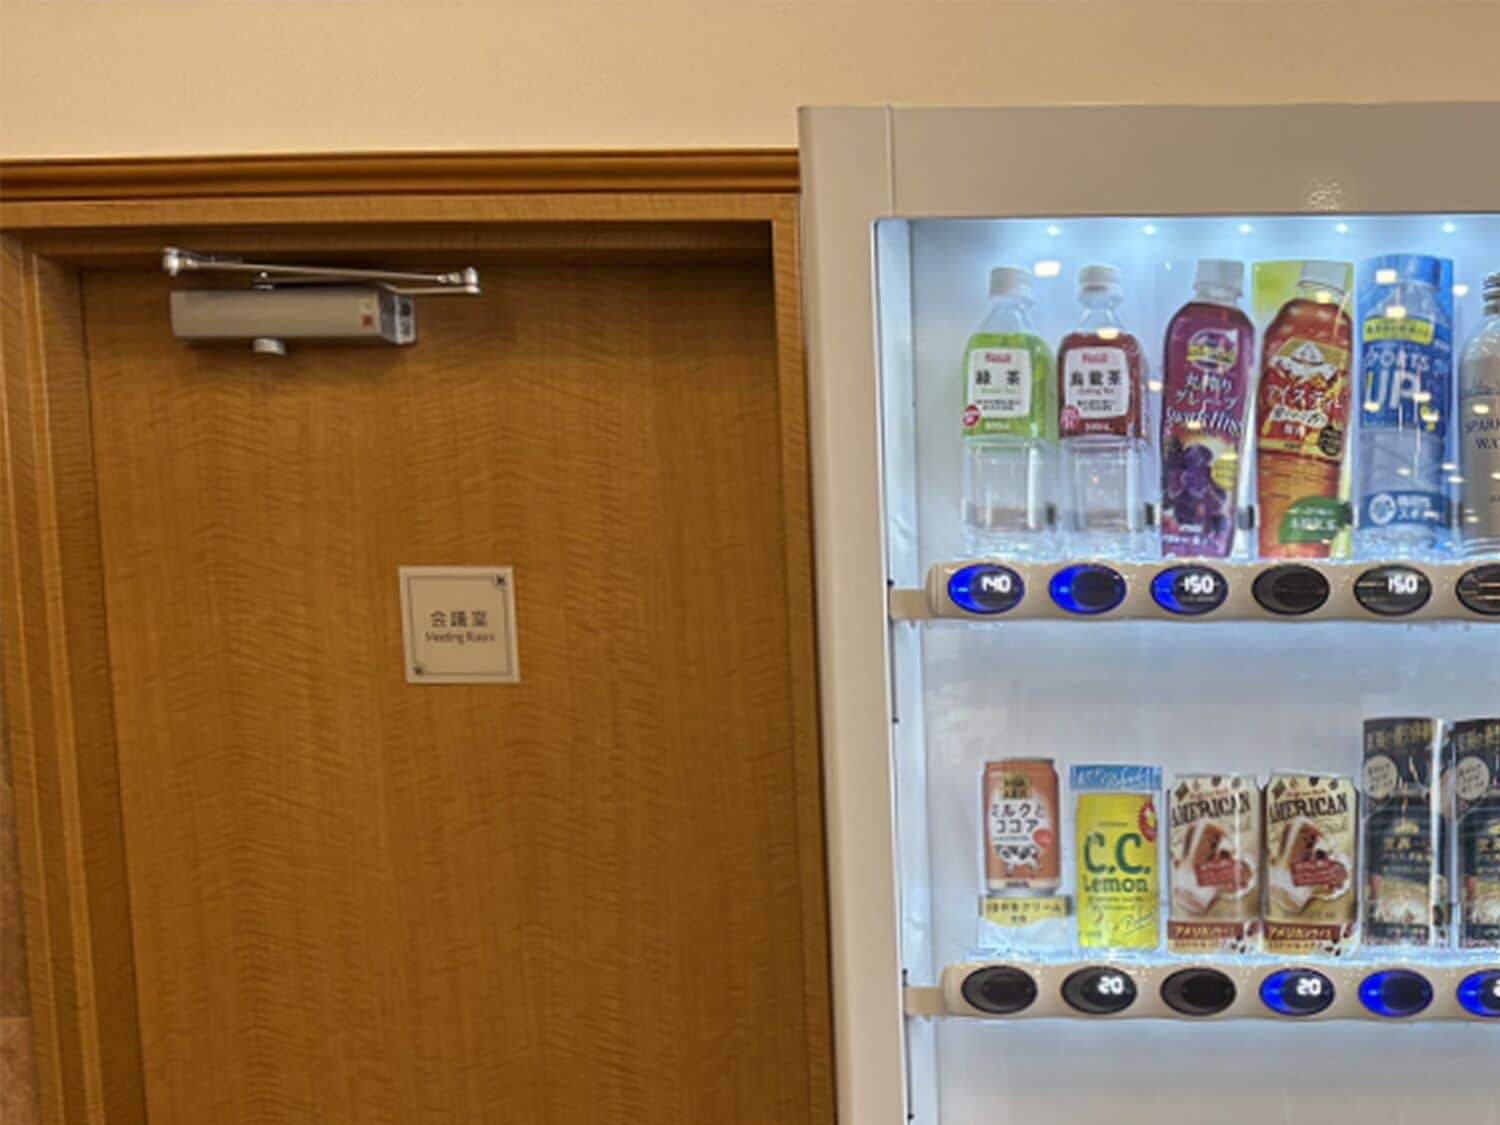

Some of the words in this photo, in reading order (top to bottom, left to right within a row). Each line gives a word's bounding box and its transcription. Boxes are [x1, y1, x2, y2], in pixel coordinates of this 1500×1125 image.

[981, 574, 1011, 593] 140
[1183, 574, 1213, 593] 150
[1387, 574, 1417, 593] 150
[430, 610, 488, 628] 会議室
[991, 803, 1046, 818] ミルクと
[1172, 792, 1250, 827] AMERICAN
[1270, 792, 1348, 824] AMERICAN
[996, 820, 1039, 834] ココア
[1084, 832, 1151, 875] C.C.
[1098, 976, 1124, 994] 20
[1296, 978, 1322, 996] 20
